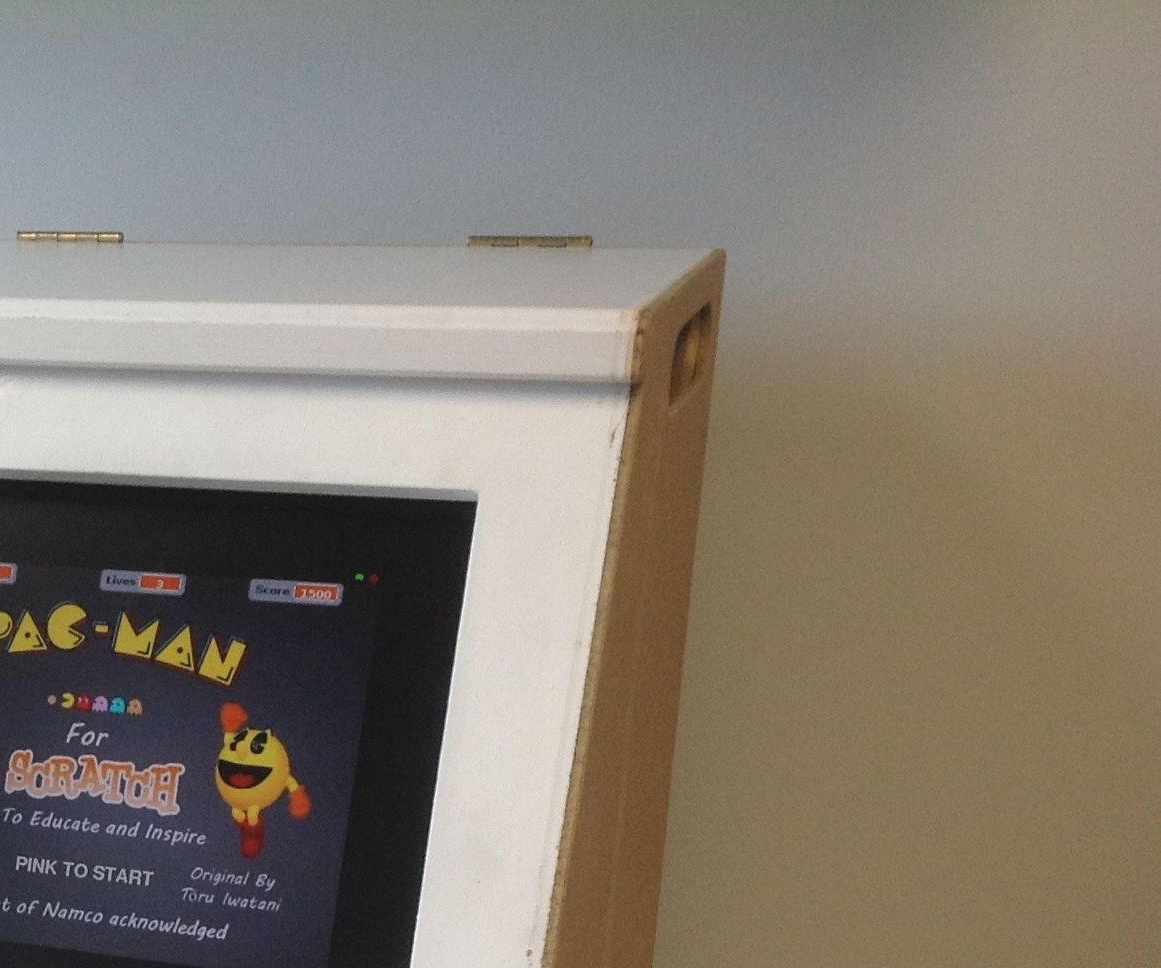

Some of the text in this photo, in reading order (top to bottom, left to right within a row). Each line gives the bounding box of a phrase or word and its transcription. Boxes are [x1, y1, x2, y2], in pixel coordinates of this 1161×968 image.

[105, 575, 164, 589] Lives 3
[255, 583, 333, 600] Score 1500
[65, 722, 109, 747] For
[4, 749, 185, 816] SCRATCH
[2, 807, 207, 846] To Educate and Inspire
[15, 855, 155, 887] PINK TO START
[191, 867, 277, 892] Original By
[181, 887, 283, 912] Toru Iwatani
[16, 900, 40, 915] of
[42, 902, 104, 924] Namco
[109, 912, 231, 941] acknowledged
